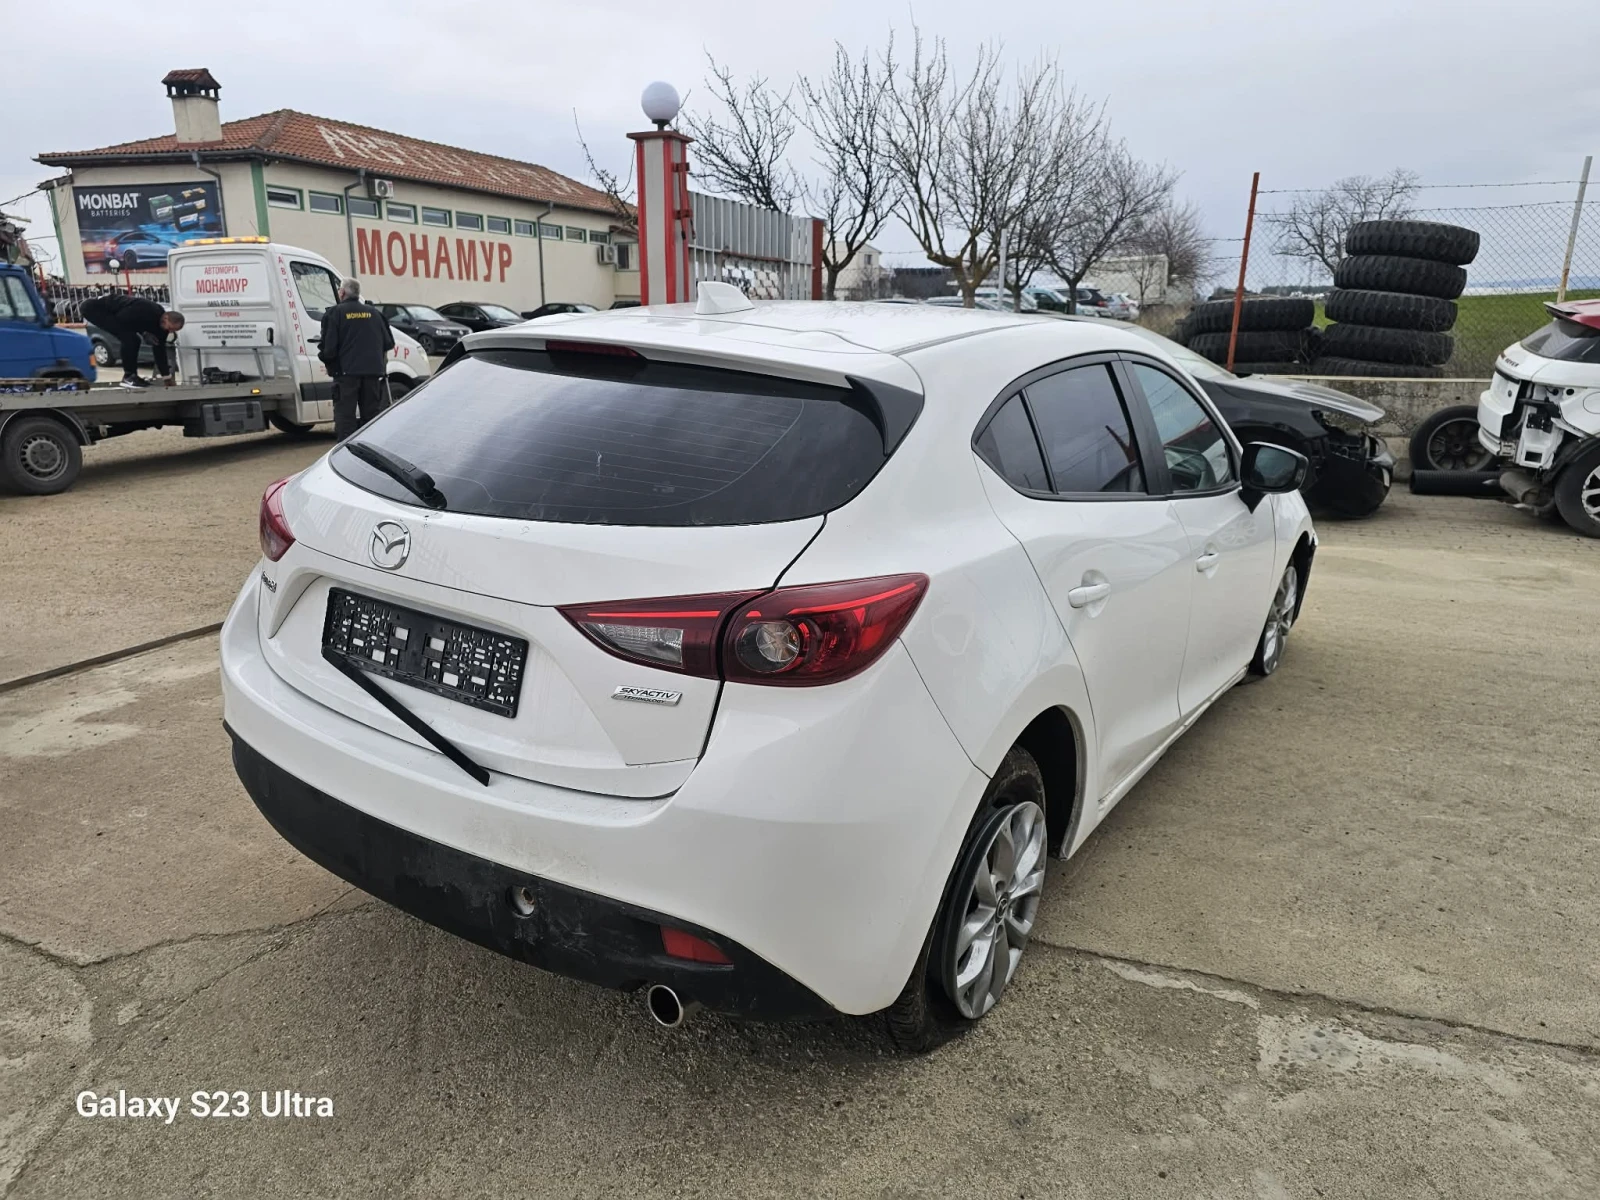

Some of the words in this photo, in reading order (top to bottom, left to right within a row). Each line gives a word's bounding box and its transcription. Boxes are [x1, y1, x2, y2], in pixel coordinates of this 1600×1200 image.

[79, 193, 139, 209] MONBAT
[91, 209, 131, 217] BATTERIES
[357, 228, 512, 283] МОНАМУР
[204, 266, 239, 275] АВТОМОРГА
[196, 279, 248, 293] МОНАМУР
[619, 687, 675, 699] SKYACTIV
